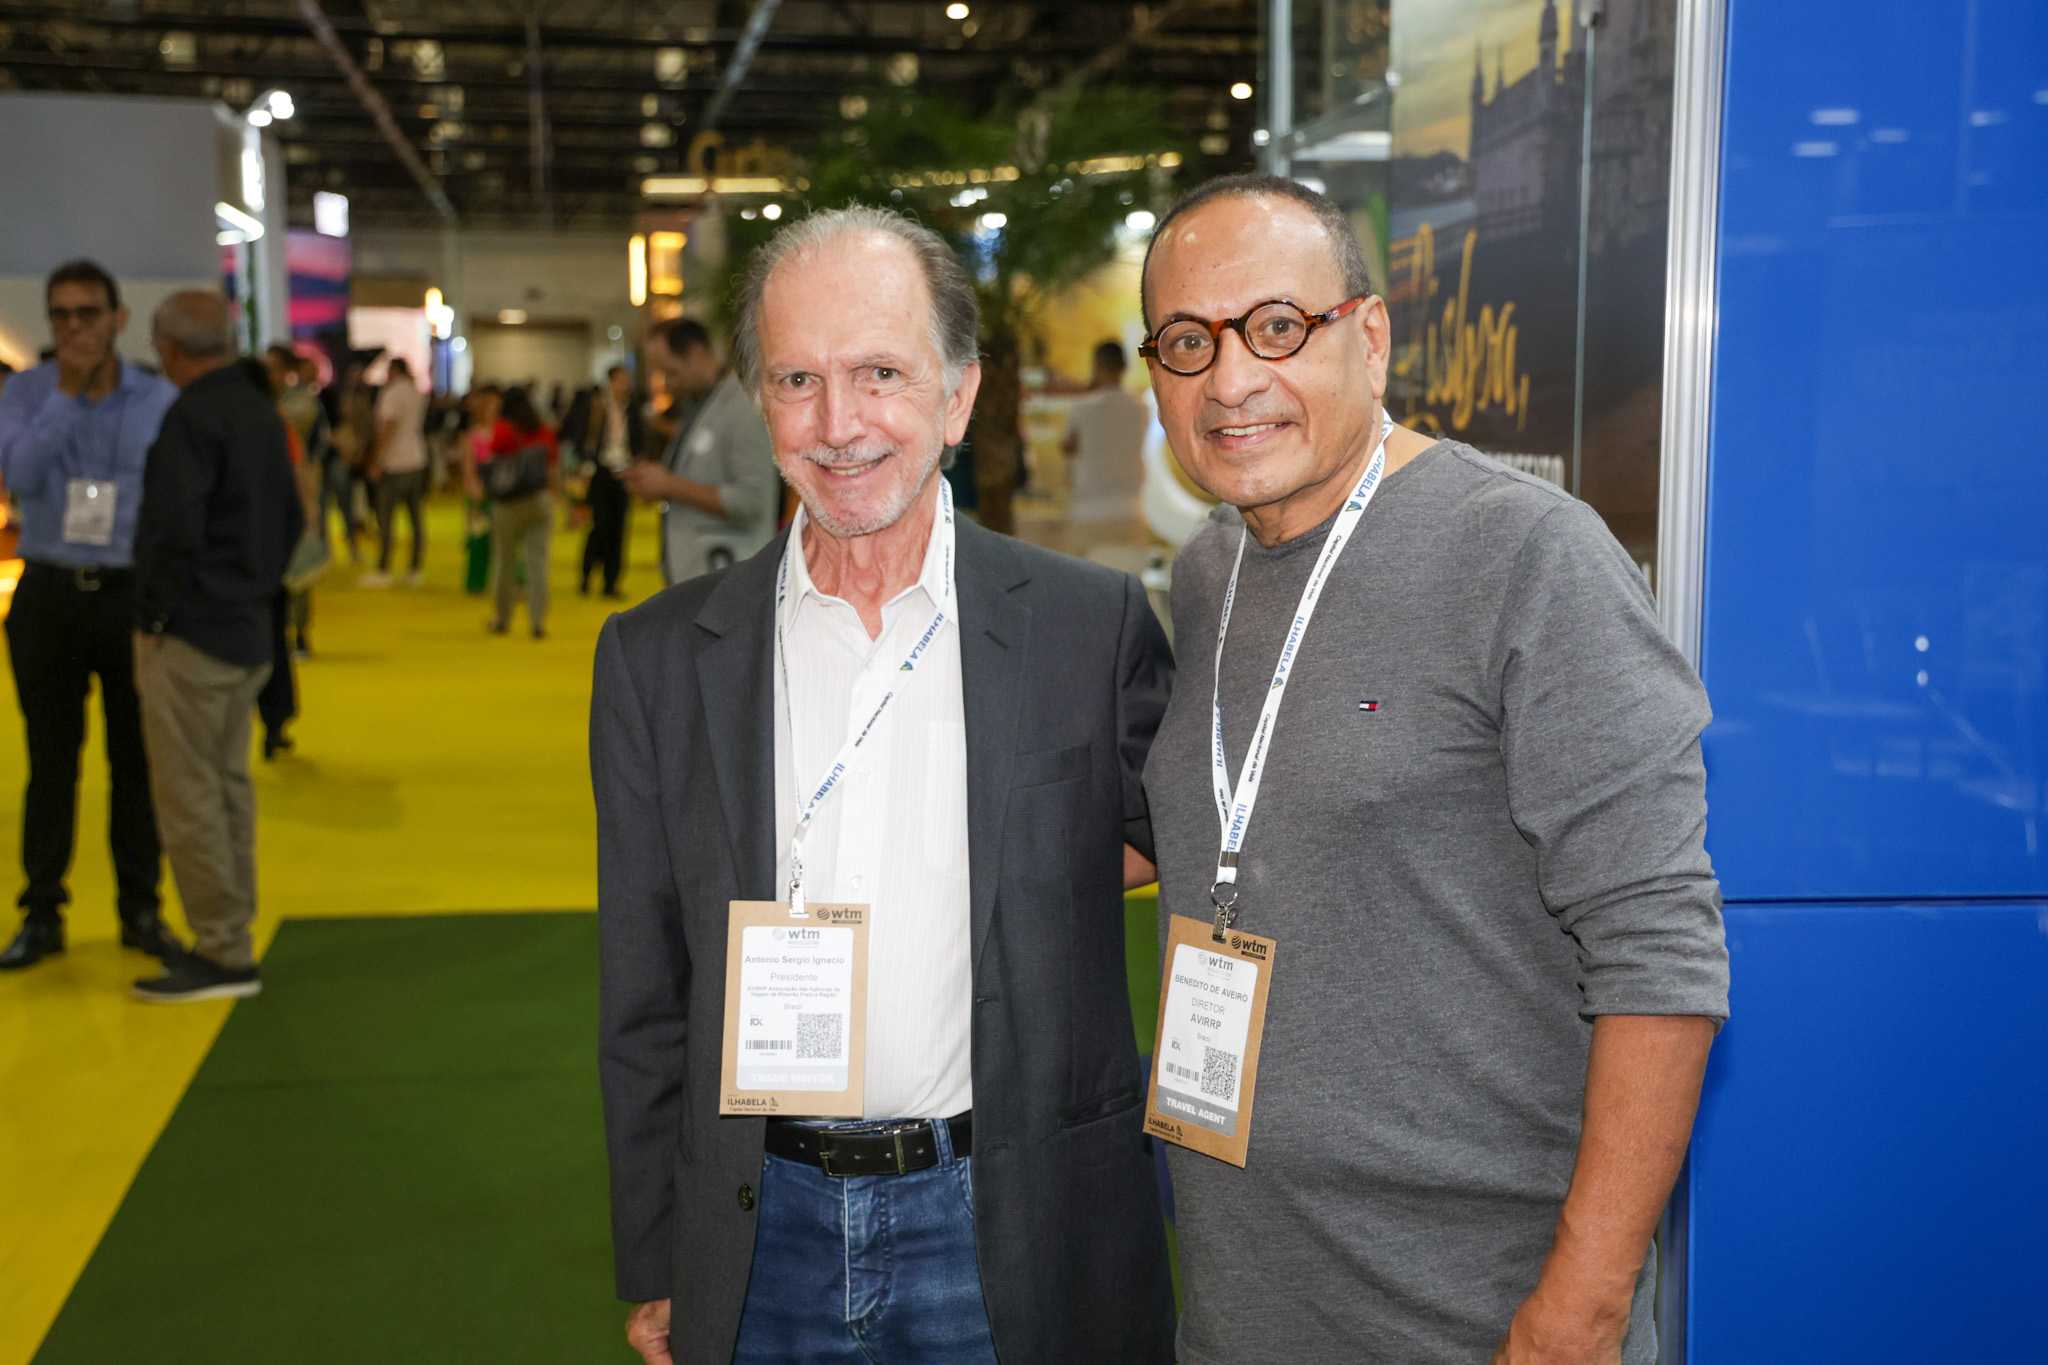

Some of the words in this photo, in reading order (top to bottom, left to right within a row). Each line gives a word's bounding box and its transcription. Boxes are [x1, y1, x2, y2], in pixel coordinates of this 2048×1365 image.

[909, 612, 944, 659] ILHABELA
[1278, 615, 1304, 673] ILHABELA
[808, 762, 845, 809] ILHABELA
[1226, 803, 1247, 852] ILHABEL
[832, 908, 862, 919] wtm
[788, 928, 820, 940] wtm
[1242, 939, 1267, 955] wtm
[745, 955, 780, 964] Antonio
[782, 955, 810, 966] Sergio
[813, 955, 845, 966] Ignacio
[1208, 956, 1233, 972] wtm
[770, 972, 818, 982] Presidente
[1174, 974, 1209, 991] BENEDITO
[1210, 984, 1220, 995] DE
[1221, 988, 1248, 1003] AVEIRO
[1191, 997, 1225, 1015] DIRETOR
[1190, 1013, 1222, 1030] AVIRRP
[1196, 1032, 1212, 1043] Brazil
[752, 1073, 787, 1083] TRADE
[790, 1074, 834, 1083] VISITOR
[727, 1098, 767, 1106] ILHABELA
[1165, 1097, 1197, 1115] TRAVEL
[1198, 1108, 1226, 1125] AGENT
[1148, 1116, 1175, 1132] ILHABELA
